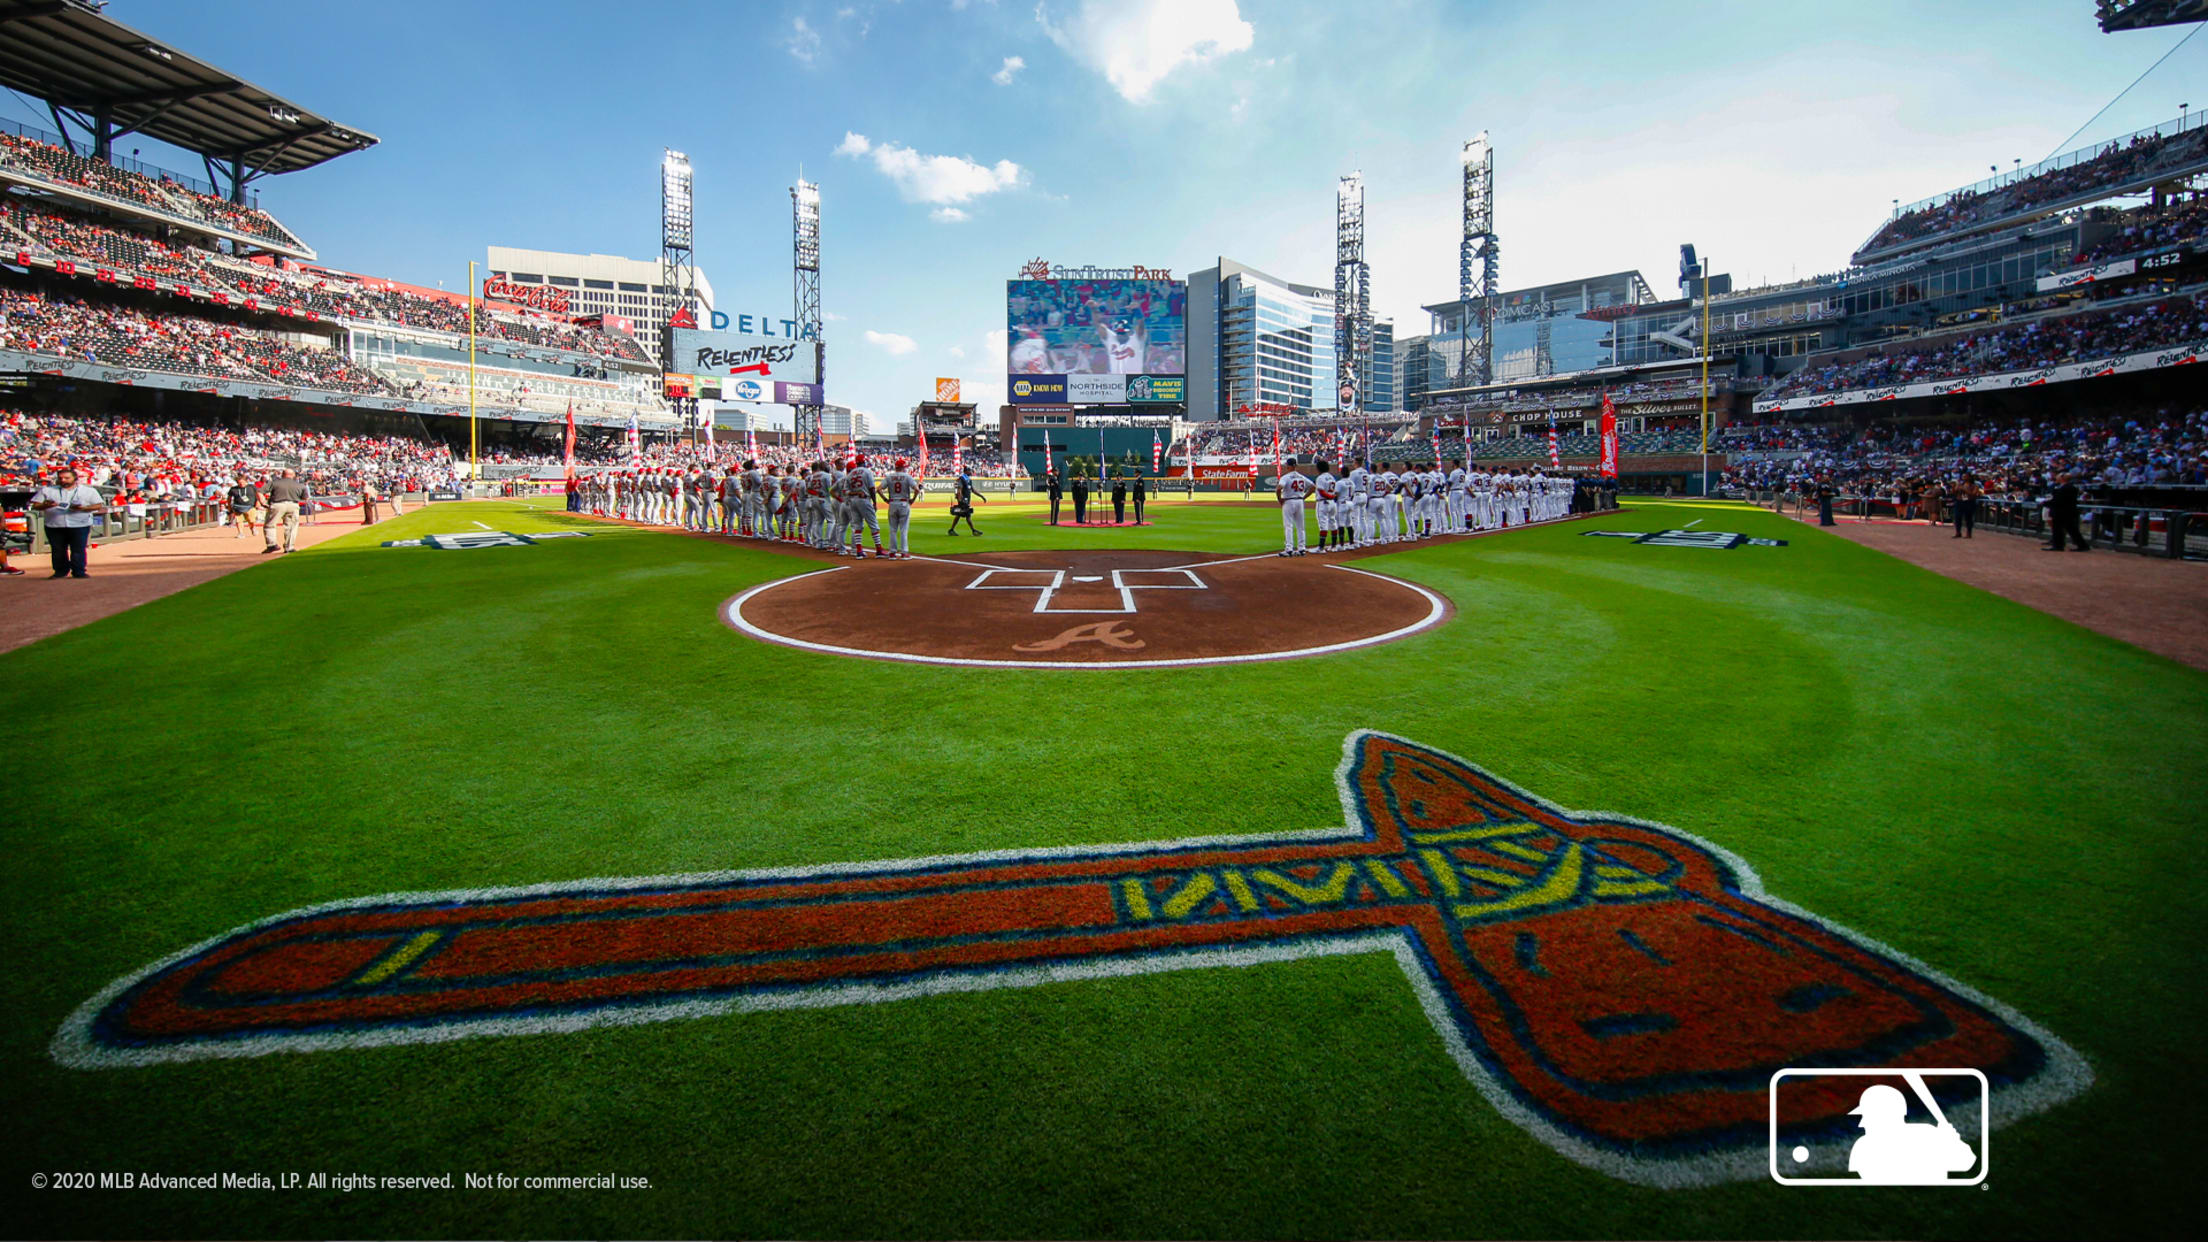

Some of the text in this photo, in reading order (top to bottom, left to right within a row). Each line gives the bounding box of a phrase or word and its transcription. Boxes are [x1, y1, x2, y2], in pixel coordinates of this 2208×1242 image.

[17, 252, 31, 267] 6
[2142, 253, 2181, 268] 4:52
[56, 260, 76, 275] 10
[96, 269, 117, 284] 21
[134, 275, 157, 291] 29
[174, 284, 191, 298] 31
[711, 310, 819, 341] DELTA
[697, 343, 797, 371] RELENTLESS
[737, 382, 761, 399] Kroger
[1016, 383, 1064, 393] NAPA KNOW HOW
[1512, 409, 1582, 422] CHOP HOUSE
[1632, 404, 1671, 415] Silver
[850, 475, 864, 489] 25
[894, 482, 902, 494] 8
[1290, 480, 1305, 492] 43
[1374, 481, 1385, 492] 20
